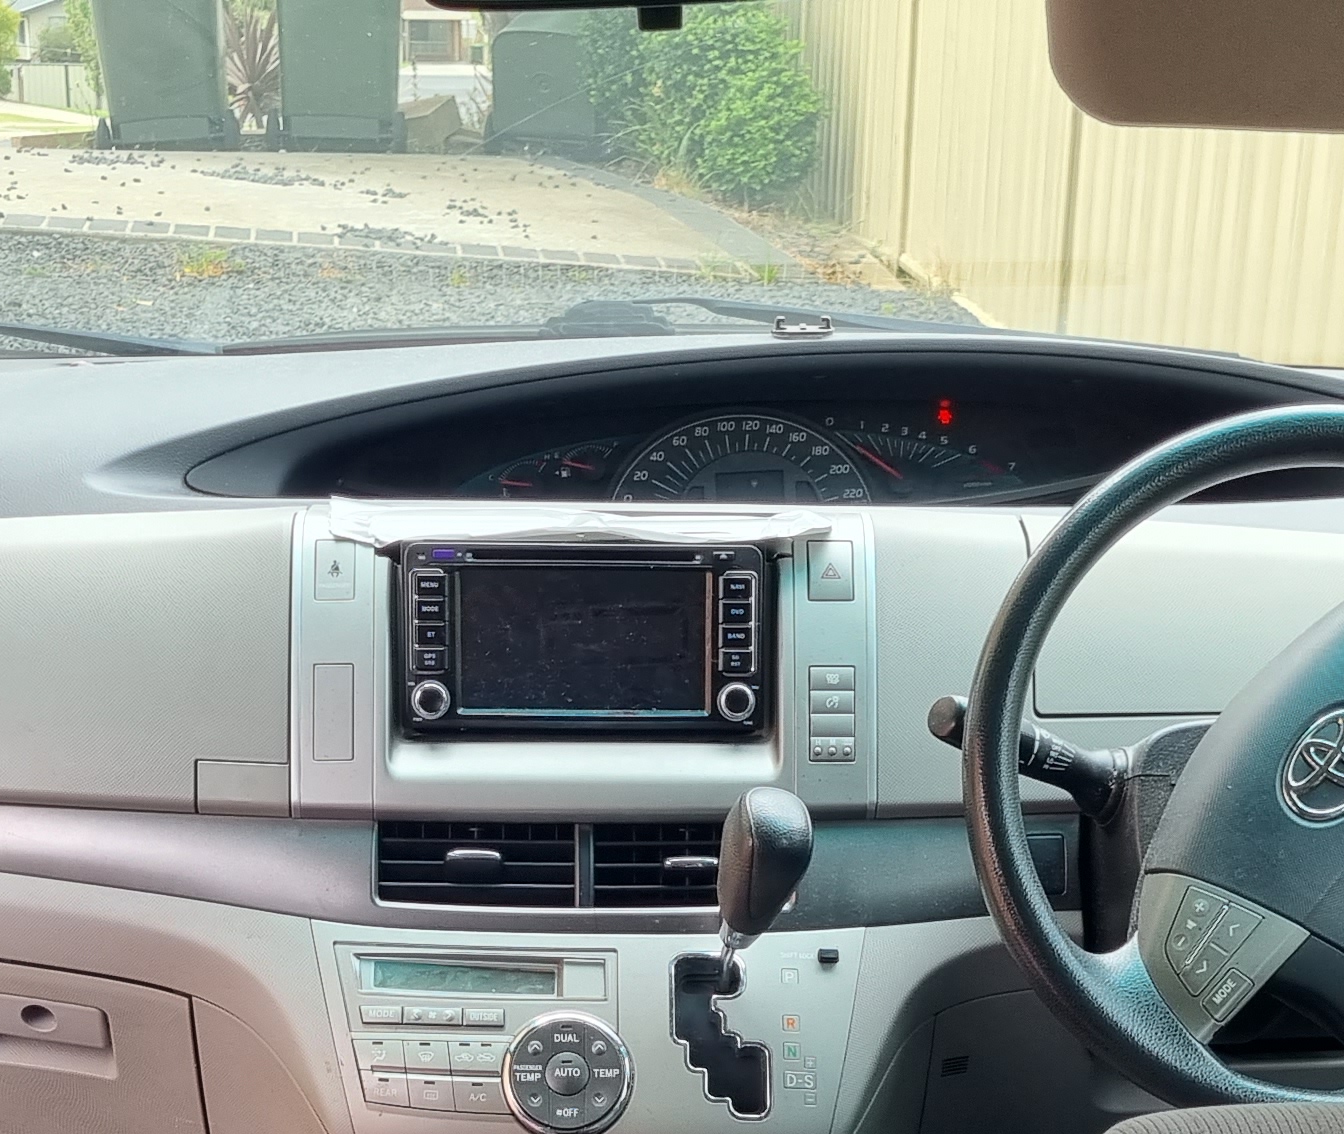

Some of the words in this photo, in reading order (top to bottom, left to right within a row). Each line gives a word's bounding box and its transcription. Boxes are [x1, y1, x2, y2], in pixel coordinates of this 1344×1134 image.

[717, 421, 735, 431] 100
[742, 420, 760, 430] 120
[825, 417, 834, 426] 0
[694, 427, 709, 436] 80
[766, 424, 784, 434] 140
[881, 424, 890, 432] 2
[901, 427, 908, 436] 3
[789, 432, 807, 442] 160
[918, 431, 926, 440] 4
[940, 436, 948, 445] 5
[672, 436, 687, 446] 60
[812, 445, 830, 455] 180
[968, 445, 977, 454] 6
[650, 451, 664, 461] 40
[829, 464, 850, 474] 200
[1008, 462, 1017, 471] 7
[633, 471, 648, 480] 20
[623, 494, 632, 502] 0
[843, 488, 863, 499] 220
[784, 972, 794, 982] P
[1212, 978, 1236, 1004] MODE
[369, 1010, 394, 1018] MODE
[469, 1012, 498, 1021] OUTSIDE
[786, 1018, 796, 1029] R
[554, 1034, 580, 1043] DUAL
[787, 1046, 797, 1057] N
[514, 1072, 542, 1082] TEMP
[554, 1067, 581, 1077] AUTO
[593, 1068, 620, 1078] TEMP
[786, 1074, 814, 1089] D-S
[374, 1088, 397, 1097] REAR
[469, 1093, 487, 1101] A/C
[562, 1108, 579, 1117] OFF
